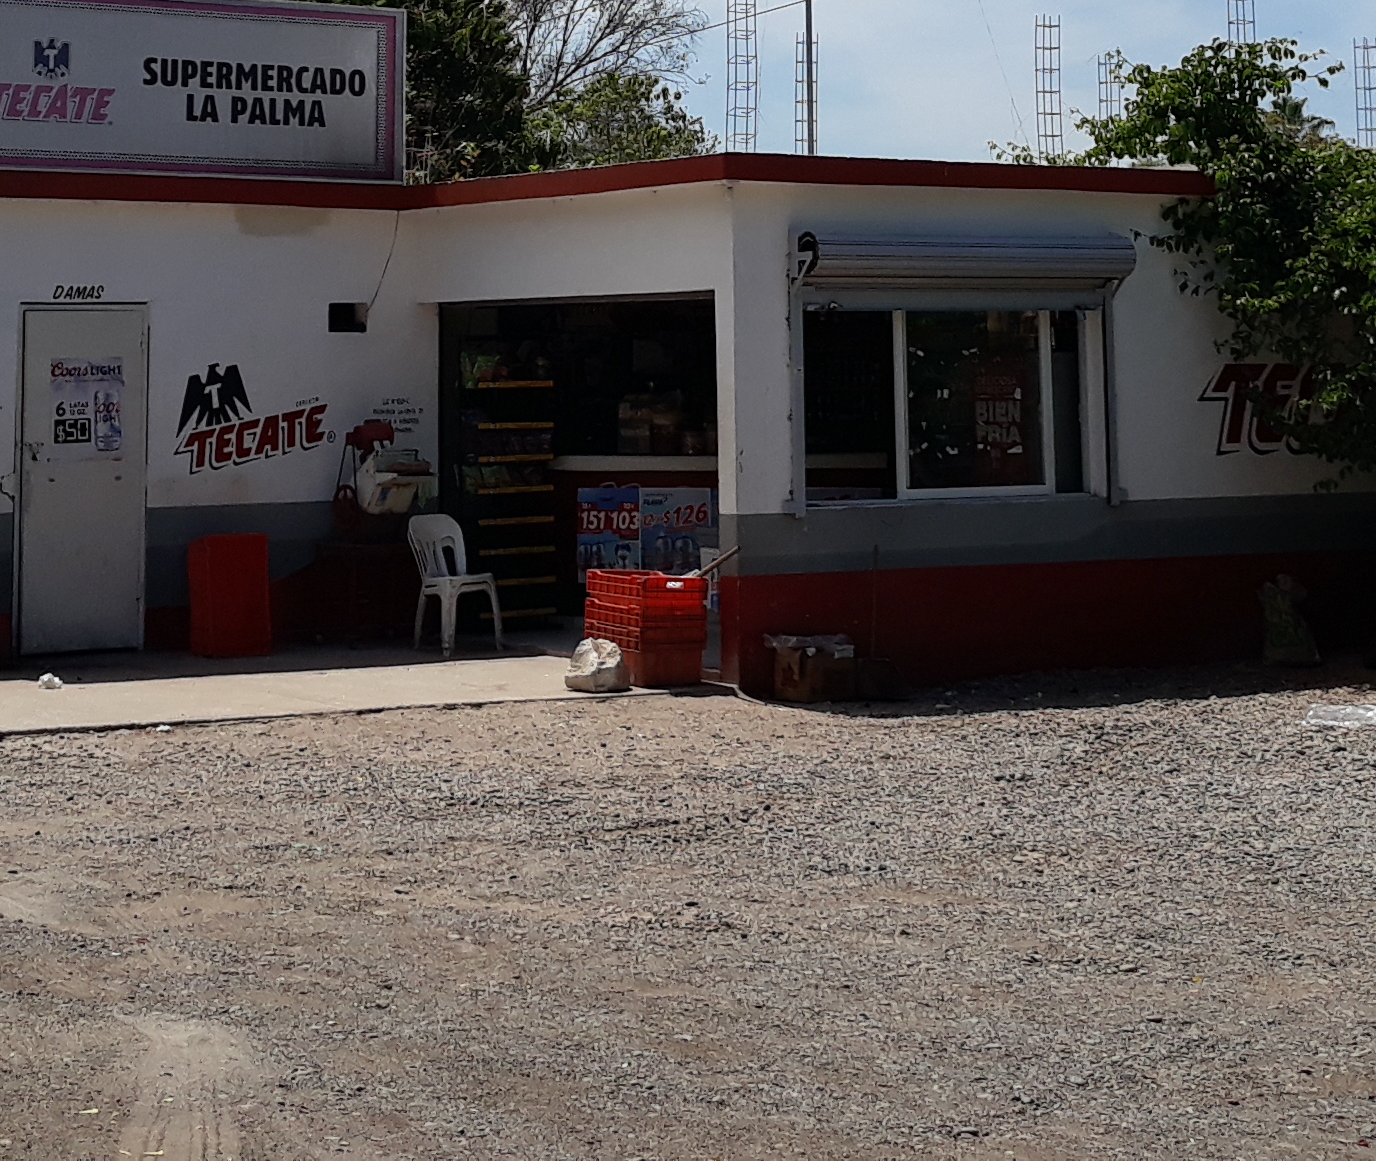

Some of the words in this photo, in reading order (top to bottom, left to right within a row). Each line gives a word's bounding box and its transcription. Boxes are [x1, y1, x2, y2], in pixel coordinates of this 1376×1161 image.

[142, 56, 367, 98] SUPERMERCADO
[186, 92, 220, 123] LA
[230, 97, 327, 129] PALMA
[52, 285, 105, 300] DAMAS
[50, 361, 88, 377] Coors
[90, 365, 121, 376] LIGHT
[55, 401, 66, 417] 6
[975, 400, 1022, 423] BIEN
[56, 419, 89, 442] $50
[174, 404, 328, 474] TECATE
